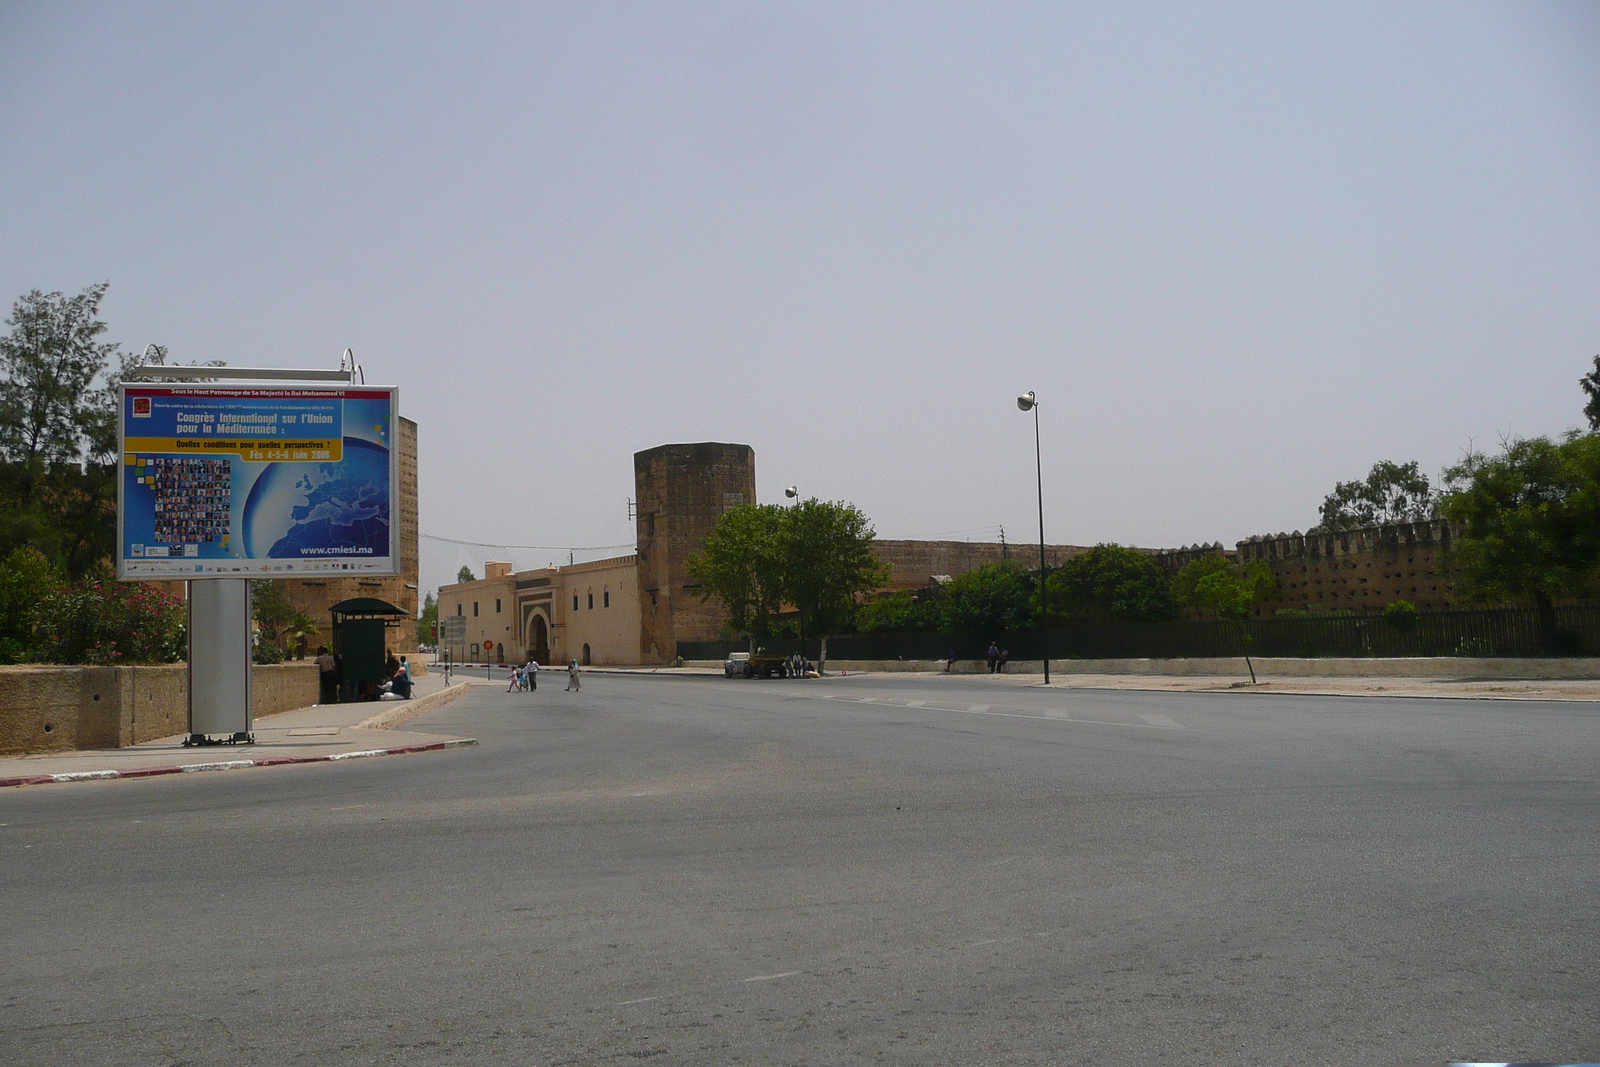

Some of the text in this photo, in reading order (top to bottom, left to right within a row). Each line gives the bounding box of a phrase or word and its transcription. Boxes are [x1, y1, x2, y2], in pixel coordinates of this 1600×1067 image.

[210, 389, 242, 397] Patronage
[176, 412, 333, 424] Congrès International sur l'Union
[176, 424, 198, 434] pour
[203, 424, 212, 434] la
[216, 423, 277, 434] Méditerranée
[258, 441, 281, 449] quelles
[284, 441, 323, 449] perspectives
[250, 450, 330, 459] Fès 4-5-6 juin 2008
[300, 545, 373, 554] www.cmiesi.ma
